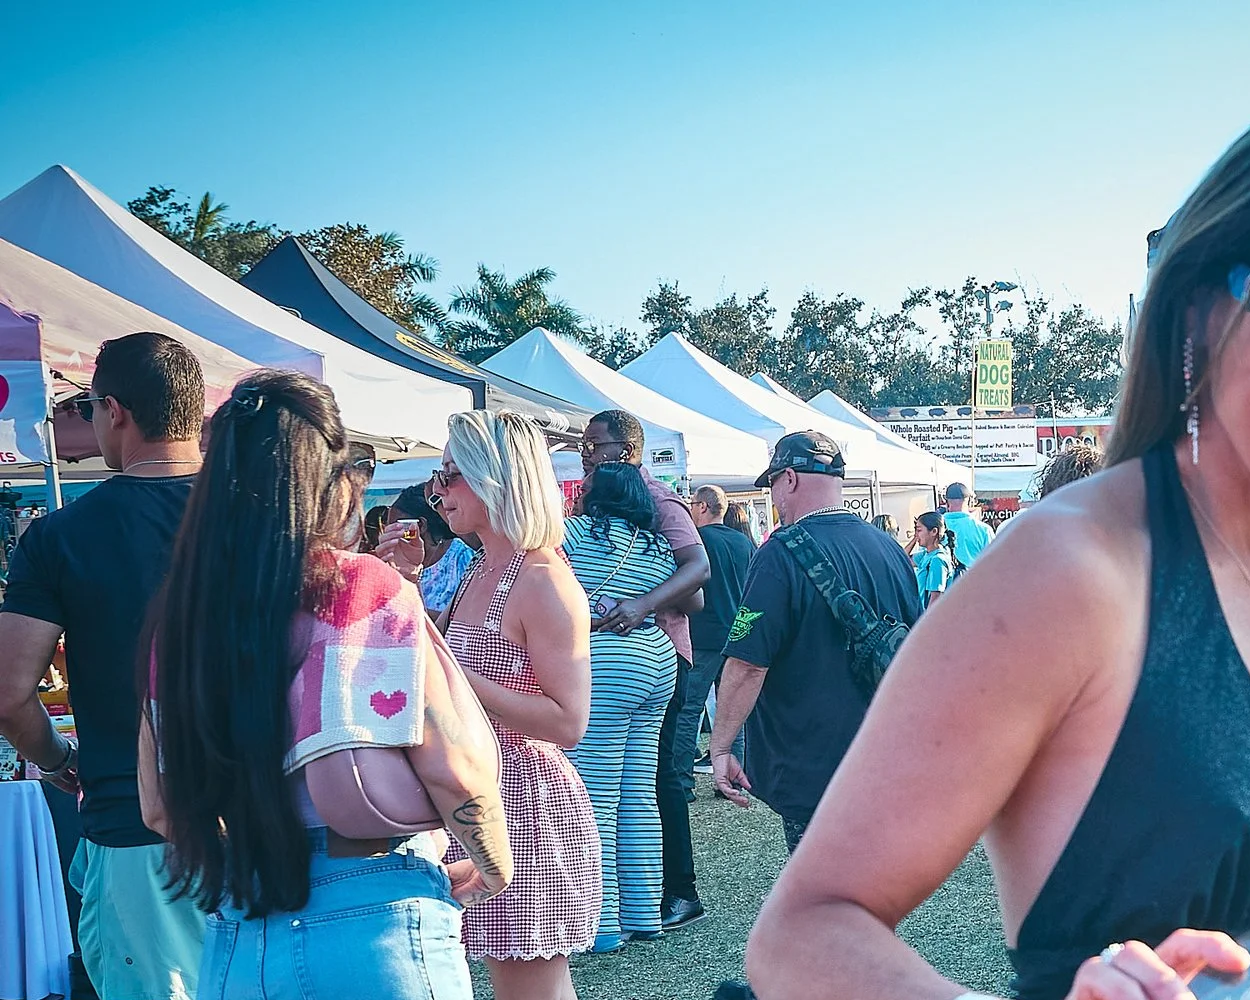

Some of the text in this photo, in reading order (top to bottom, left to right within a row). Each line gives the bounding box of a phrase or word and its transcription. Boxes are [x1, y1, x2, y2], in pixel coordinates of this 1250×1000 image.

[980, 344, 1009, 360] NATURAL
[980, 364, 1009, 385] DOG
[979, 389, 1009, 406] TREATS
[890, 424, 912, 433] Whole
[914, 424, 940, 433] Roasted
[942, 424, 953, 434] Pig
[908, 434, 930, 442] Parfait
[844, 499, 869, 510] DOG
